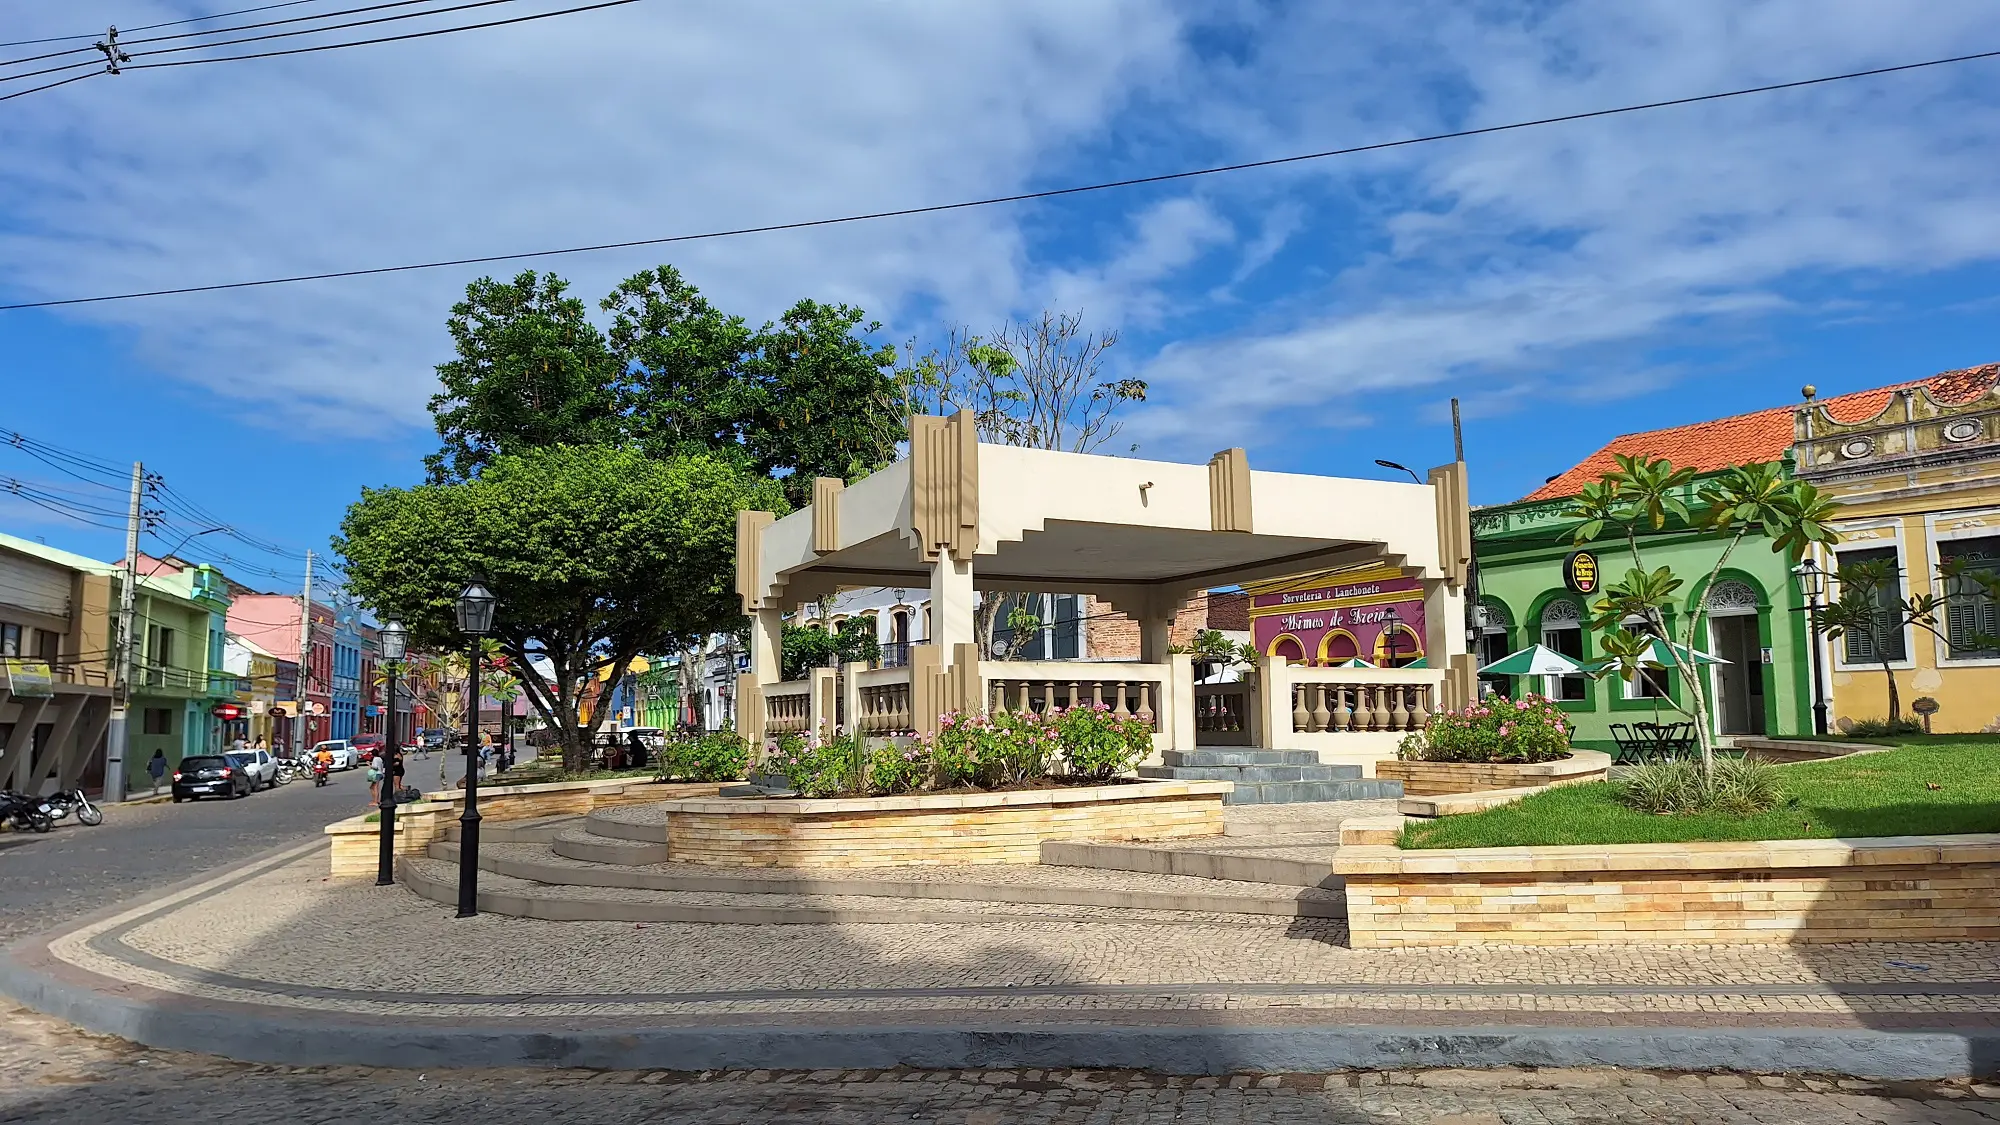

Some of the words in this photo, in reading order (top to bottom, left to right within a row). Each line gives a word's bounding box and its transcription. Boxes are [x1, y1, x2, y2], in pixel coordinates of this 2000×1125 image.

[1282, 590, 1322, 603] Sorveteria
[1335, 584, 1380, 597] Lanchonete
[1280, 614, 1324, 630] Mimos
[1329, 610, 1344, 627] de
